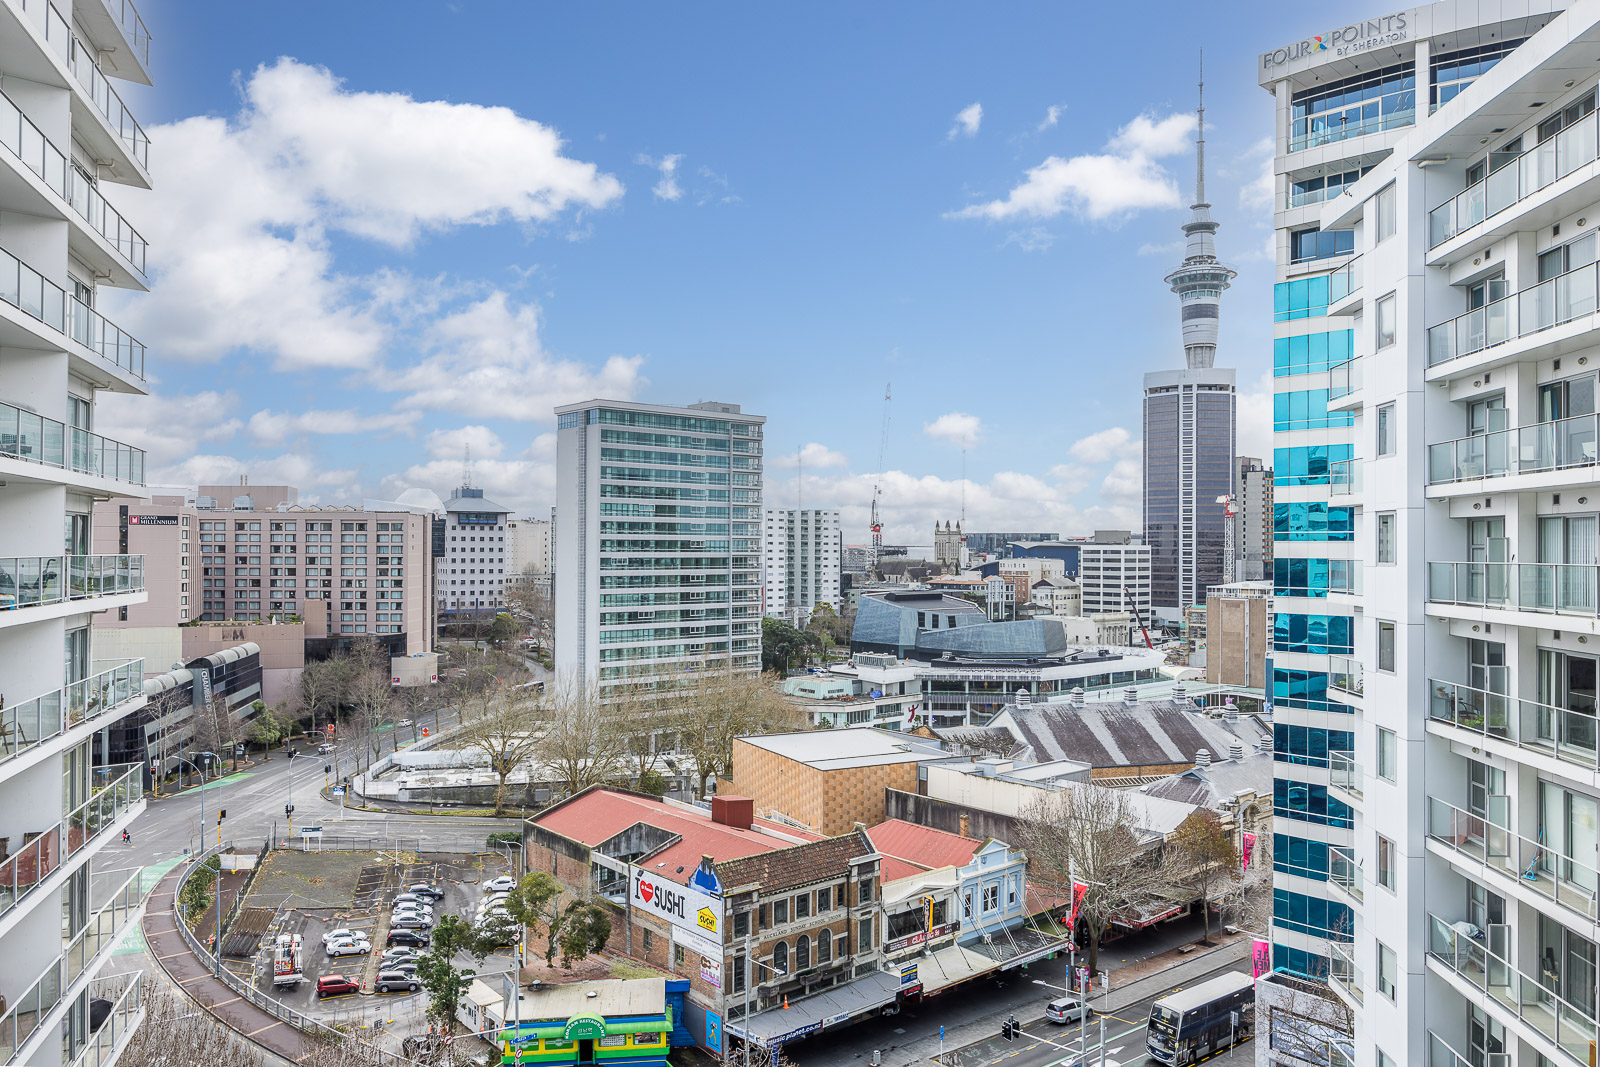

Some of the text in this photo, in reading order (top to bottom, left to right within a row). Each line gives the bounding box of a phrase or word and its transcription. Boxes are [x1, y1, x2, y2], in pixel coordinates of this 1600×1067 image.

[1263, 12, 1407, 69] FOUR POINTS
[1337, 31, 1407, 56] BY SHERATON
[635, 877, 685, 919] I SUSHI
[763, 929, 788, 940] AUCKLAND
[564, 1018, 606, 1040] KOREAN RESTAURANT
